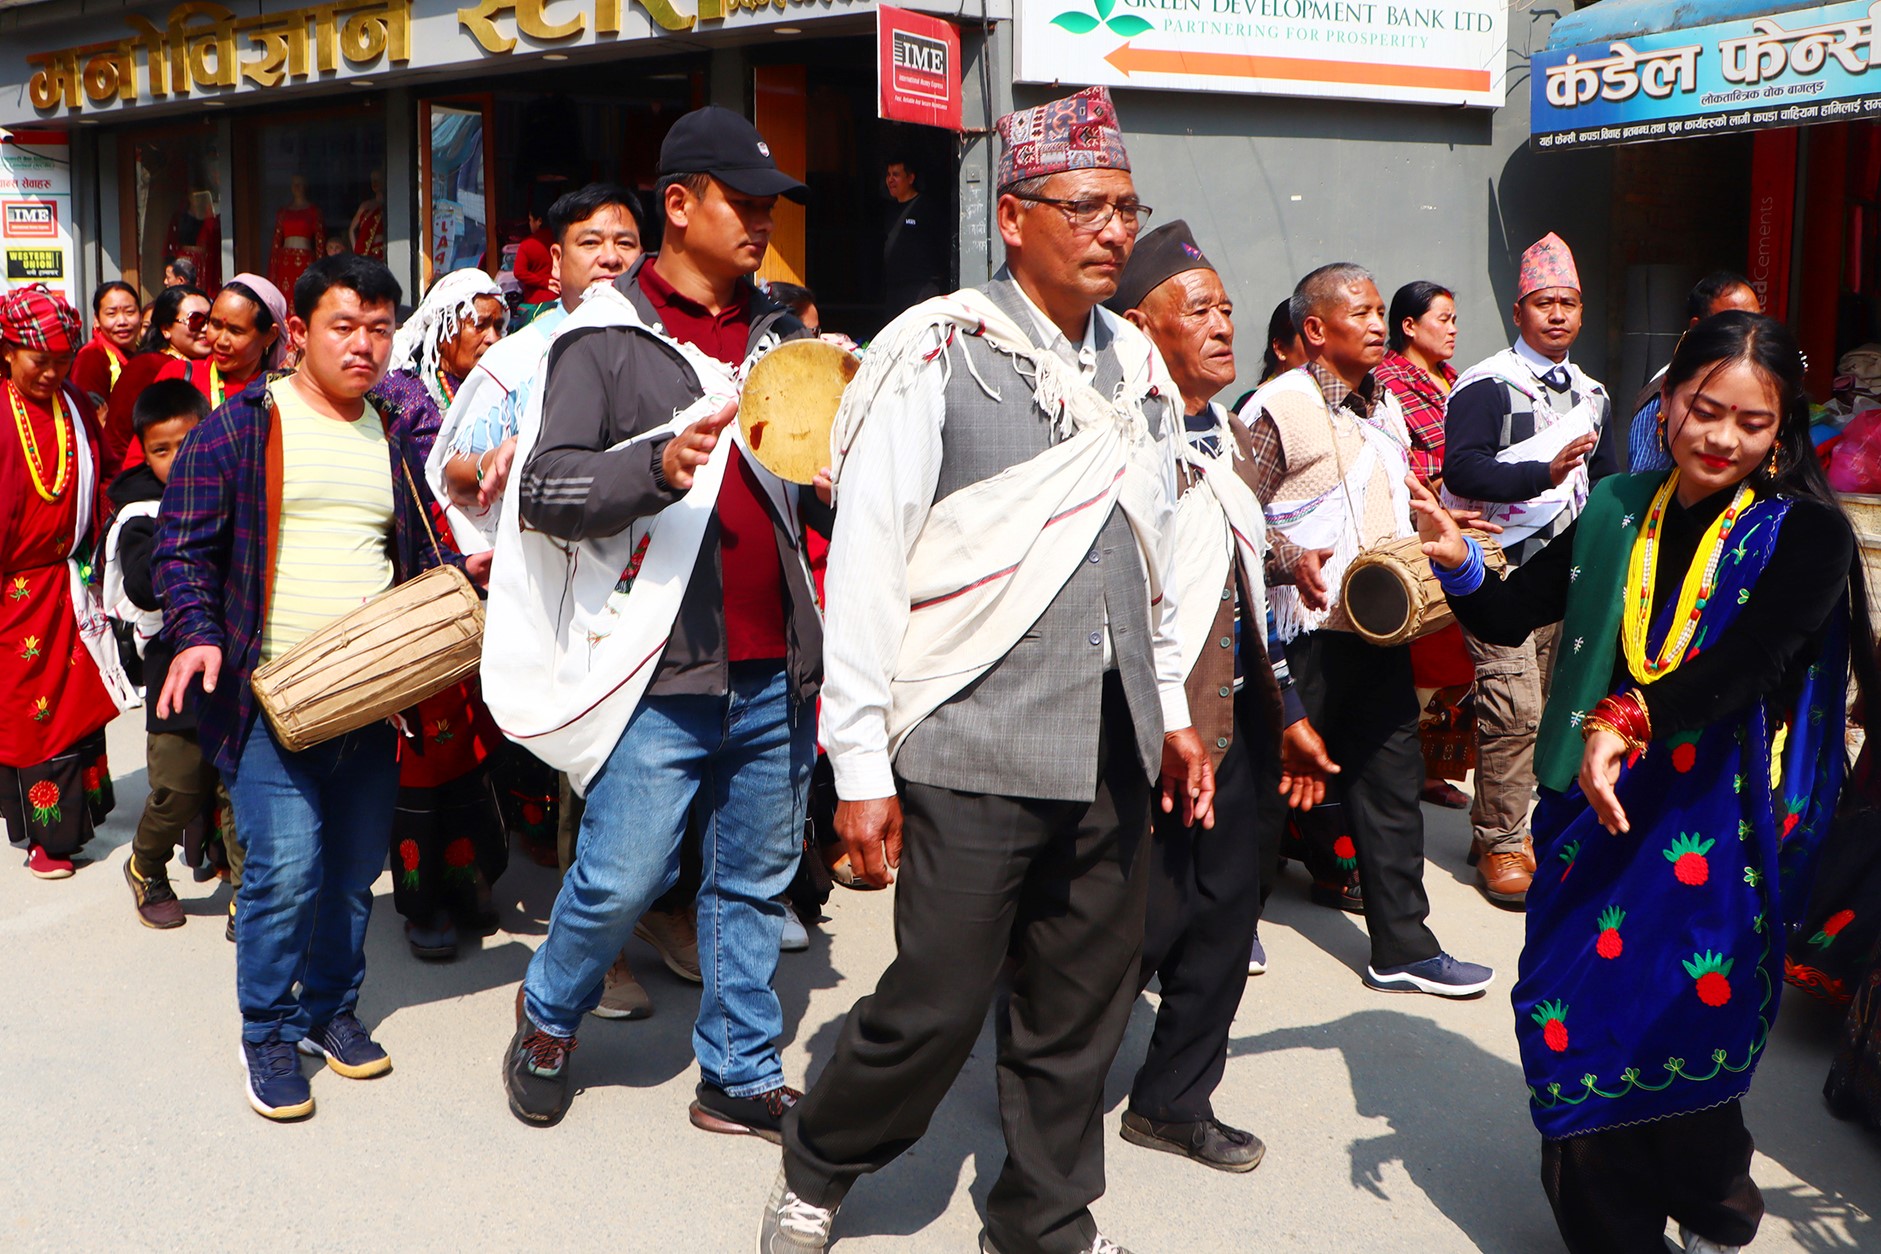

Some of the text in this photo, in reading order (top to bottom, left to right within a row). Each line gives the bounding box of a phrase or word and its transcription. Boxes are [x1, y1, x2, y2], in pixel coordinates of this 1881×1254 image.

[1213, 0, 1377, 24] DEVELOPMENT
[1387, 5, 1445, 29] BANK
[1454, 11, 1493, 33] LTD
[1164, 18, 1429, 49] PARTNERING FOR PROSPERITY
[27, 1, 411, 108] मनोविज्ञान
[903, 42, 944, 74] IME
[1546, 42, 1702, 106] कंडेल
[1764, 85, 1784, 97] चोक
[1753, 110, 1777, 123] कपडा
[14, 208, 49, 222] IME
[9, 251, 52, 260] WESTERN
[23, 260, 52, 269] UNION
